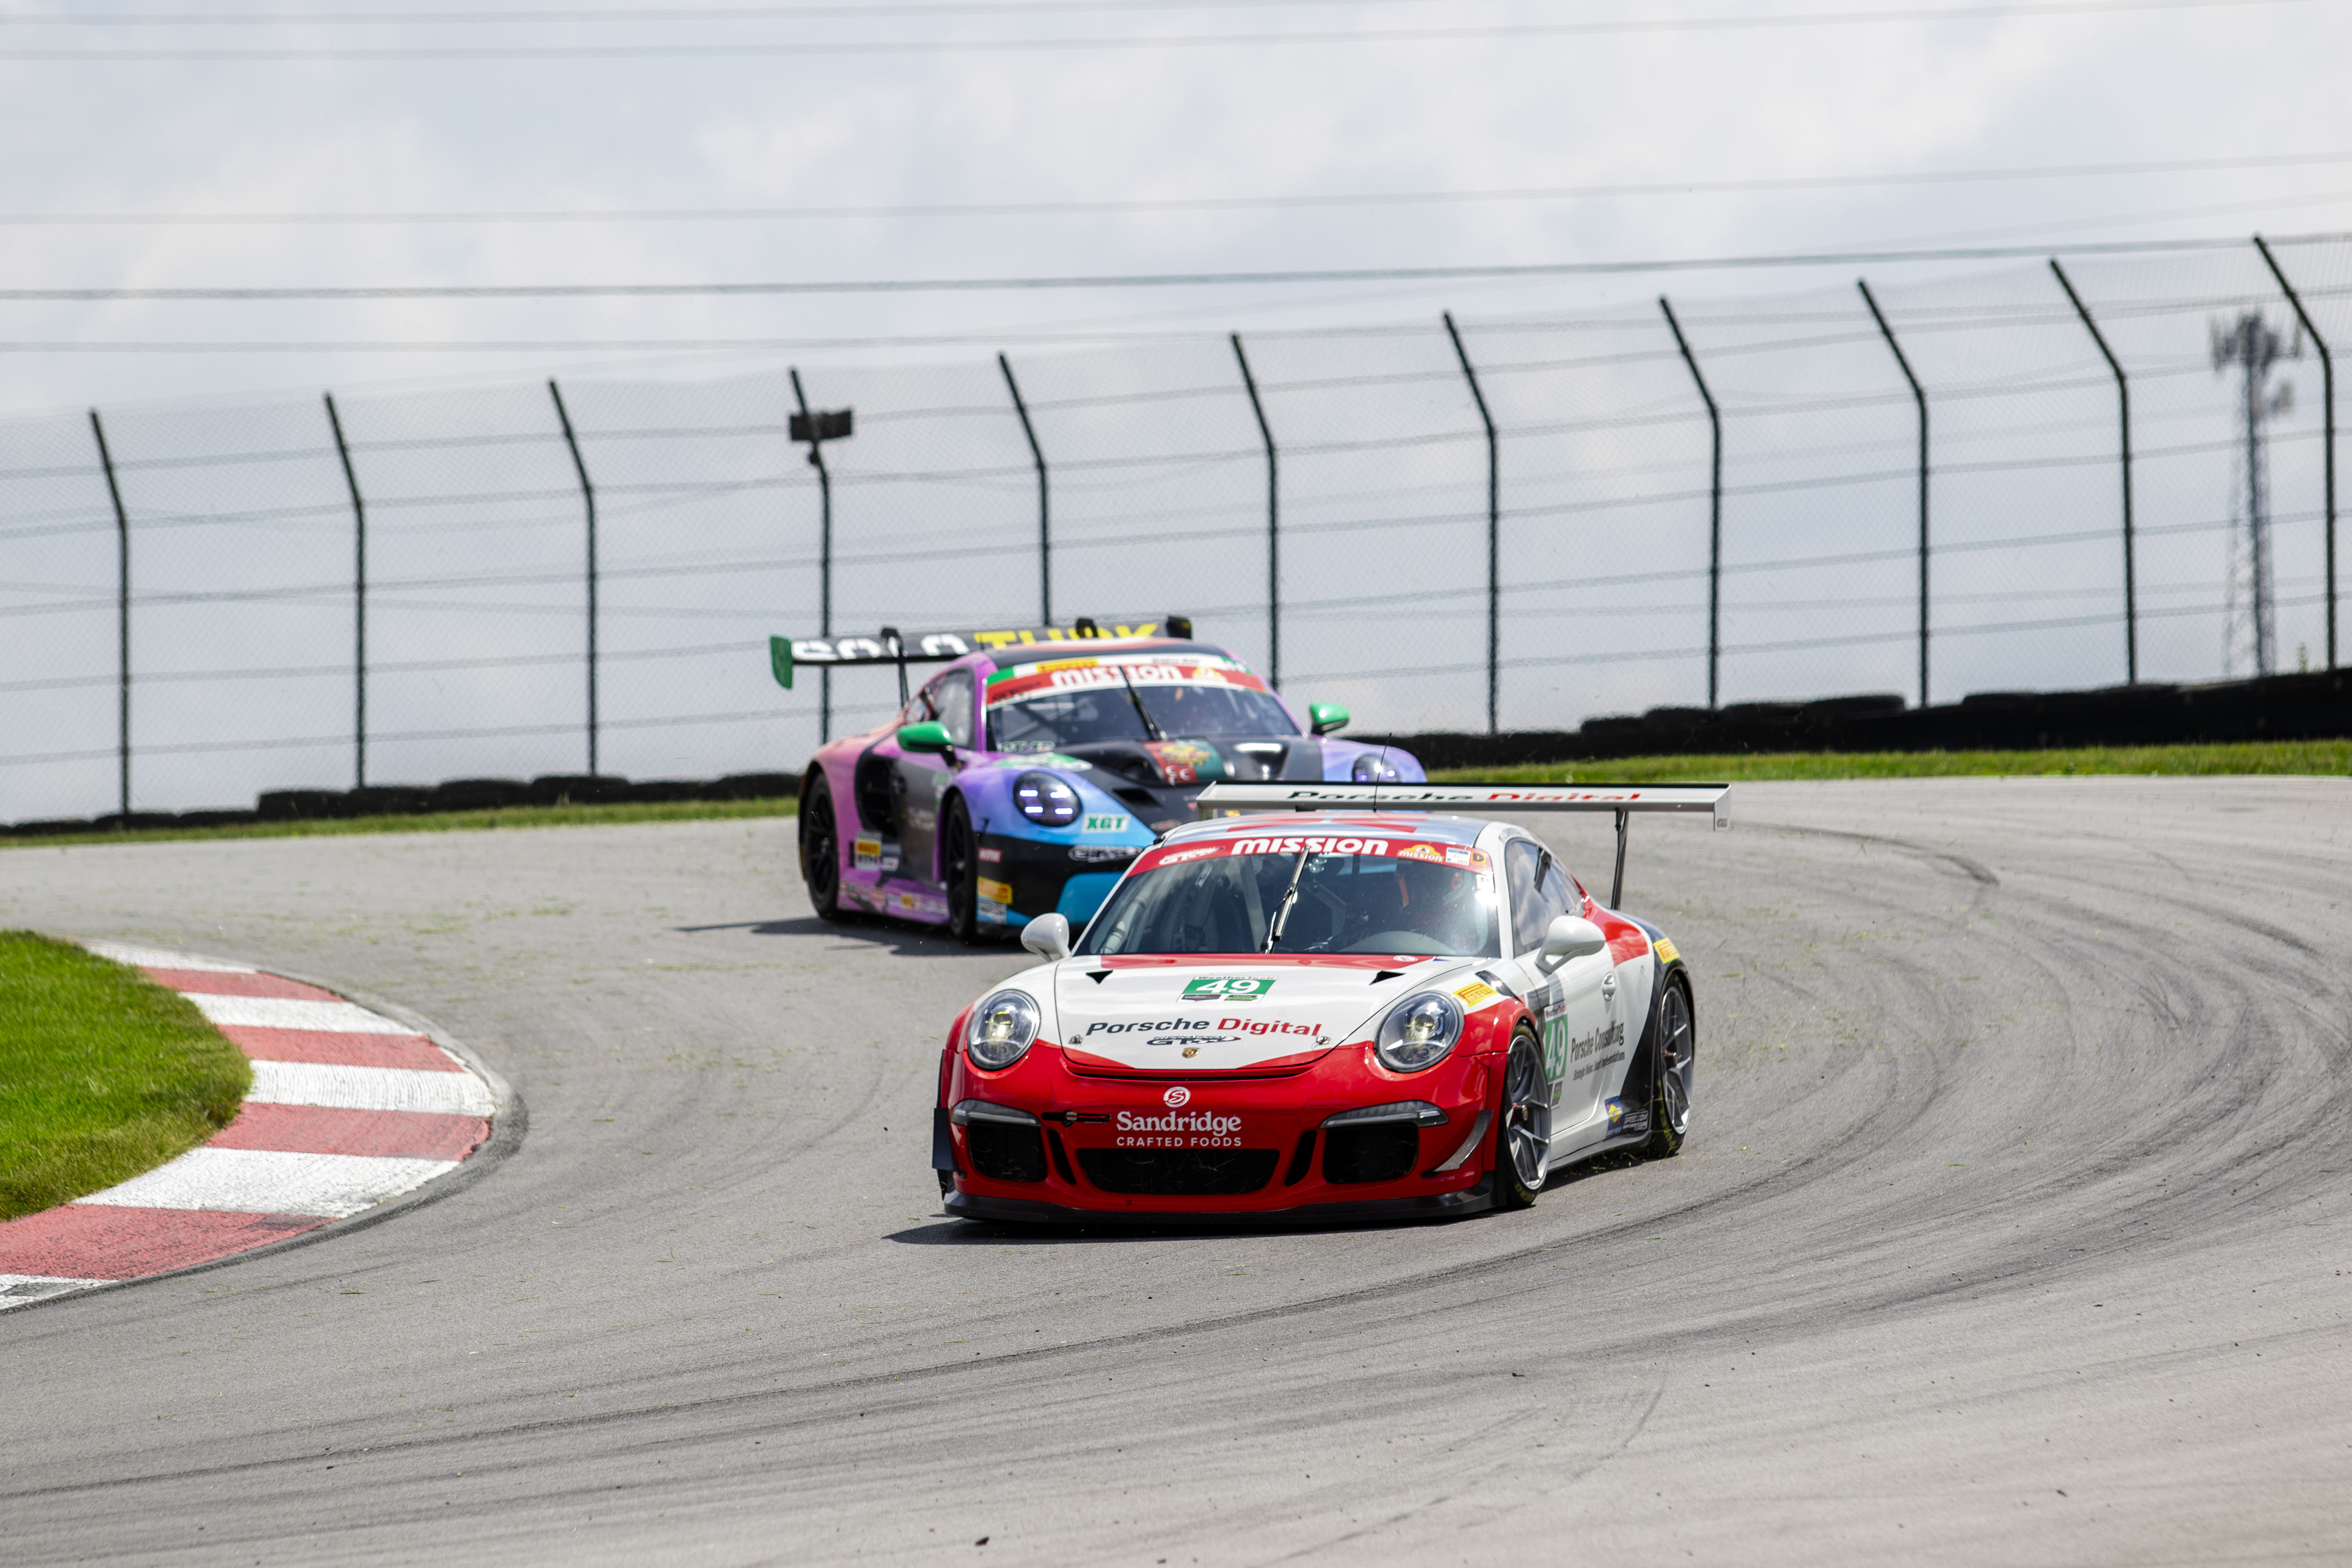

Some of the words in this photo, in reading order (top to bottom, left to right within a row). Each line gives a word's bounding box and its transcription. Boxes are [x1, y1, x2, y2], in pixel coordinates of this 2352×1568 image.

[1287, 790, 1473, 800] Porsche
[1486, 793, 1642, 802] Digital
[1087, 817, 1124, 829] XGT
[1473, 852, 1485, 862] D
[1195, 980, 1261, 994] 49
[1458, 983, 1493, 1003] PIRELLI
[1086, 1018, 1210, 1036] Porsche
[1217, 1018, 1322, 1036] Digital
[1546, 1020, 1565, 1078] 49
[1570, 1031, 1594, 1063] Porsche
[1116, 1110, 1242, 1137] Sandridge
[1116, 1136, 1183, 1147] CRAFTED
[1191, 1136, 1242, 1147] FOODS
